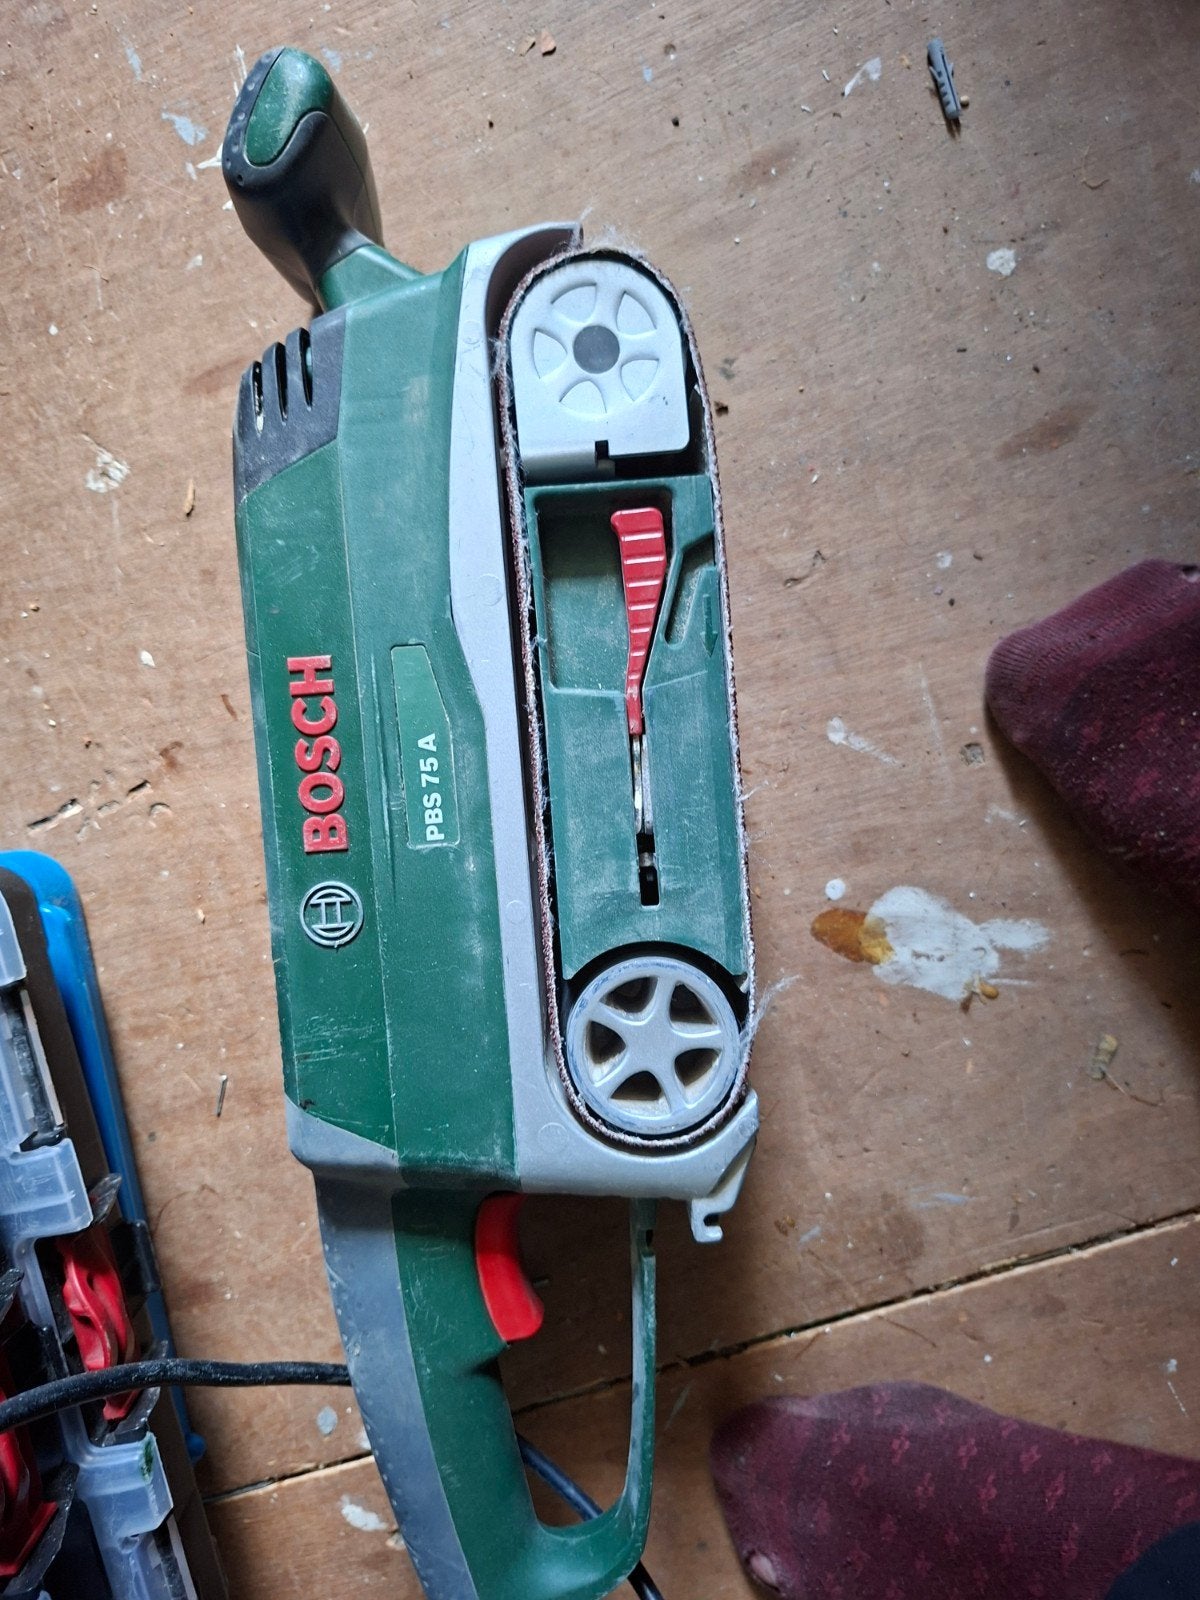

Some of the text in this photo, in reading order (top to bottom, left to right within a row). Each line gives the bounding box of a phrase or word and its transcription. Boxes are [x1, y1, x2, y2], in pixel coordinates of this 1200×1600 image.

[287, 655, 349, 853] BOSCH
[417, 733, 445, 842] PBS 75 A
